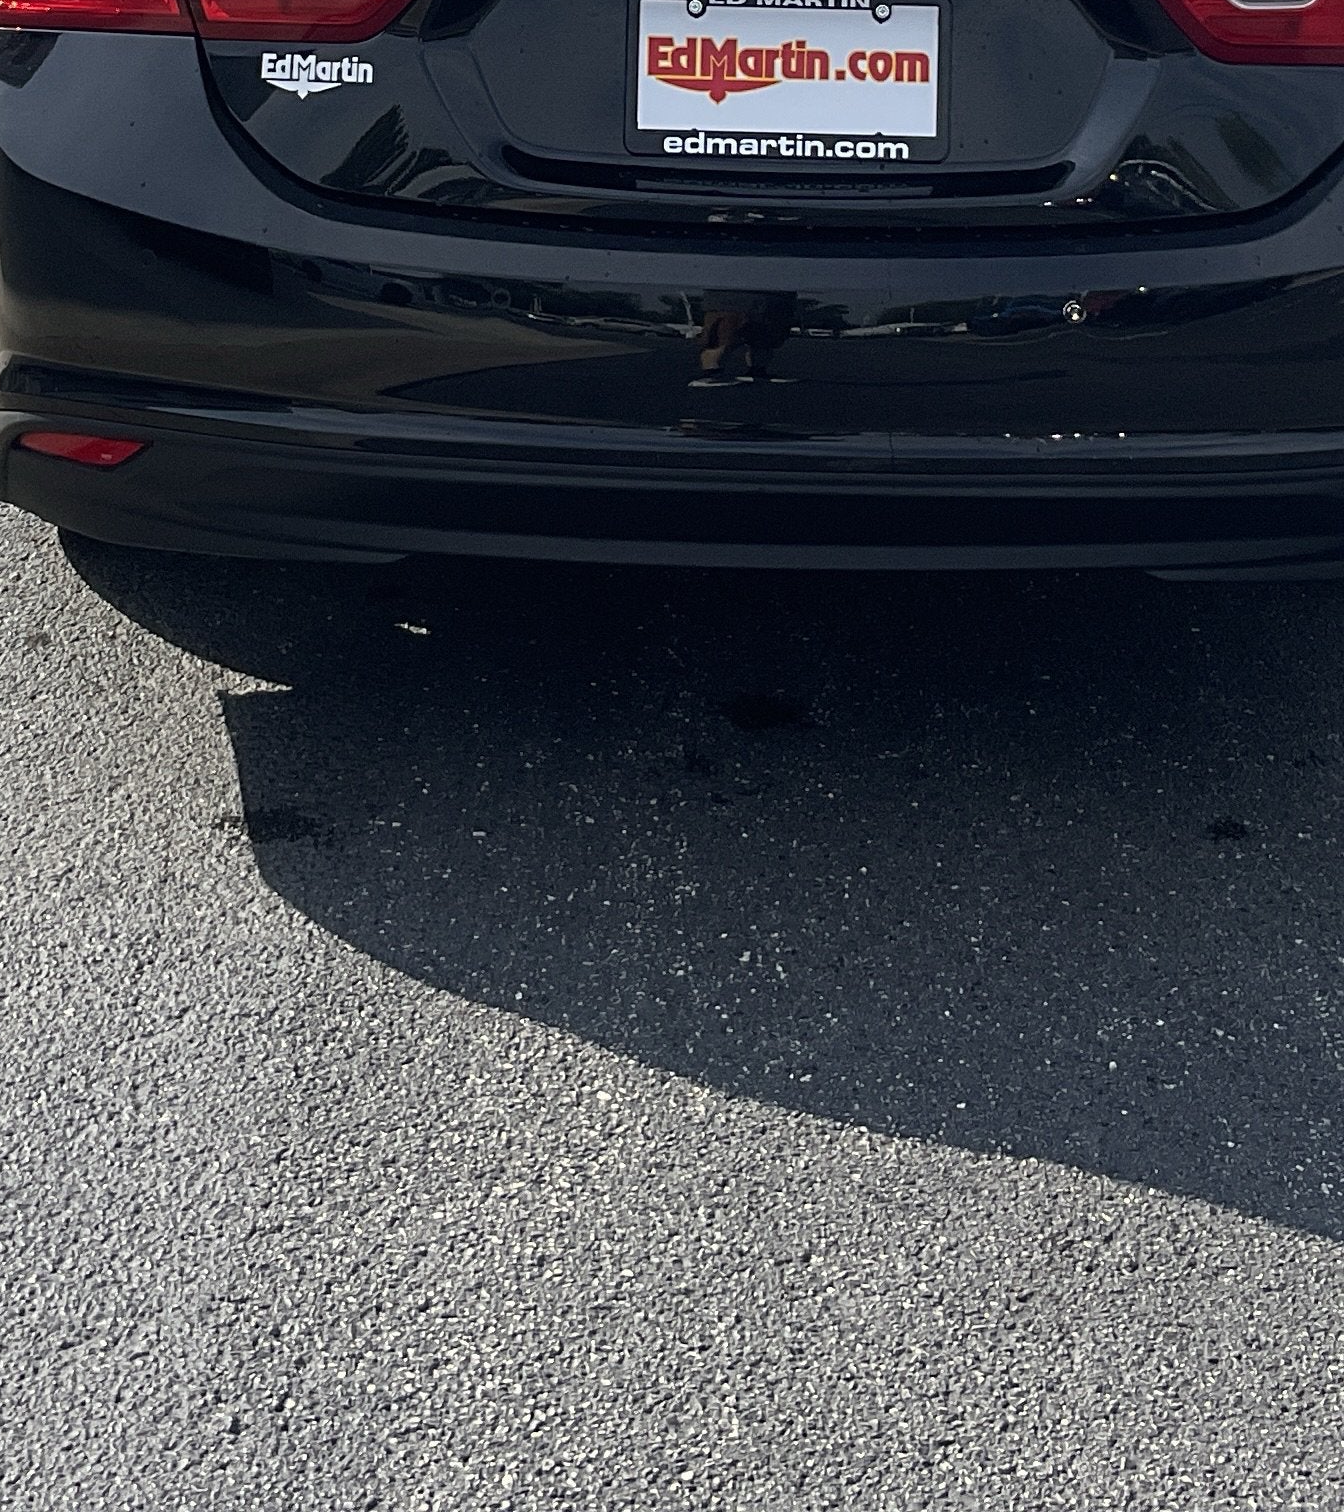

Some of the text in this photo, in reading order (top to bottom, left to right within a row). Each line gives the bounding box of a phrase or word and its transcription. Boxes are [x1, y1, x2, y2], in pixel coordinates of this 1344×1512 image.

[261, 52, 374, 84] EdMartin
[647, 35, 931, 83] EdMartin.com
[663, 131, 910, 160] edmartin.com
